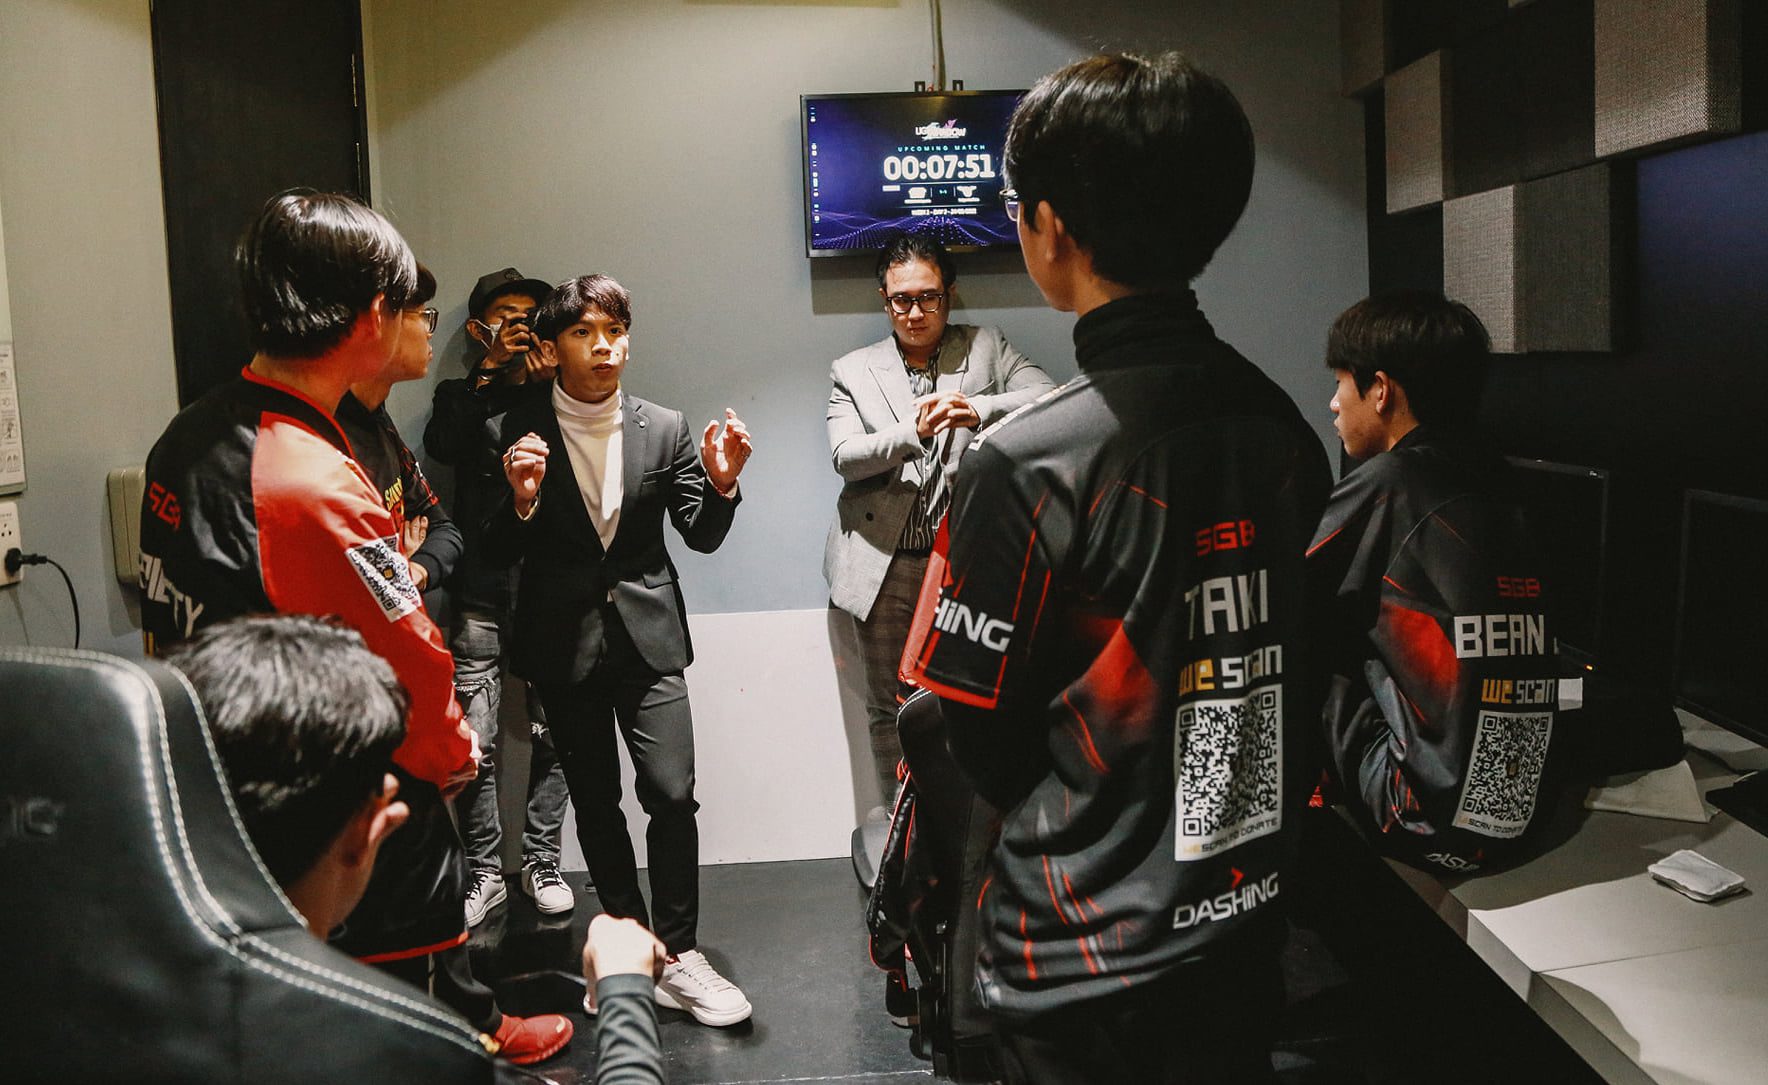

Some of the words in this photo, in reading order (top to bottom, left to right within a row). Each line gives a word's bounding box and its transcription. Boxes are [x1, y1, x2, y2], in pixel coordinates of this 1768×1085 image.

[883, 153, 996, 181] 00:07:51
[1496, 576, 1541, 598] SGB
[1184, 568, 1269, 641] TAKI
[1453, 614, 1545, 659] BEAN
[1240, 818, 1278, 836] DONATE
